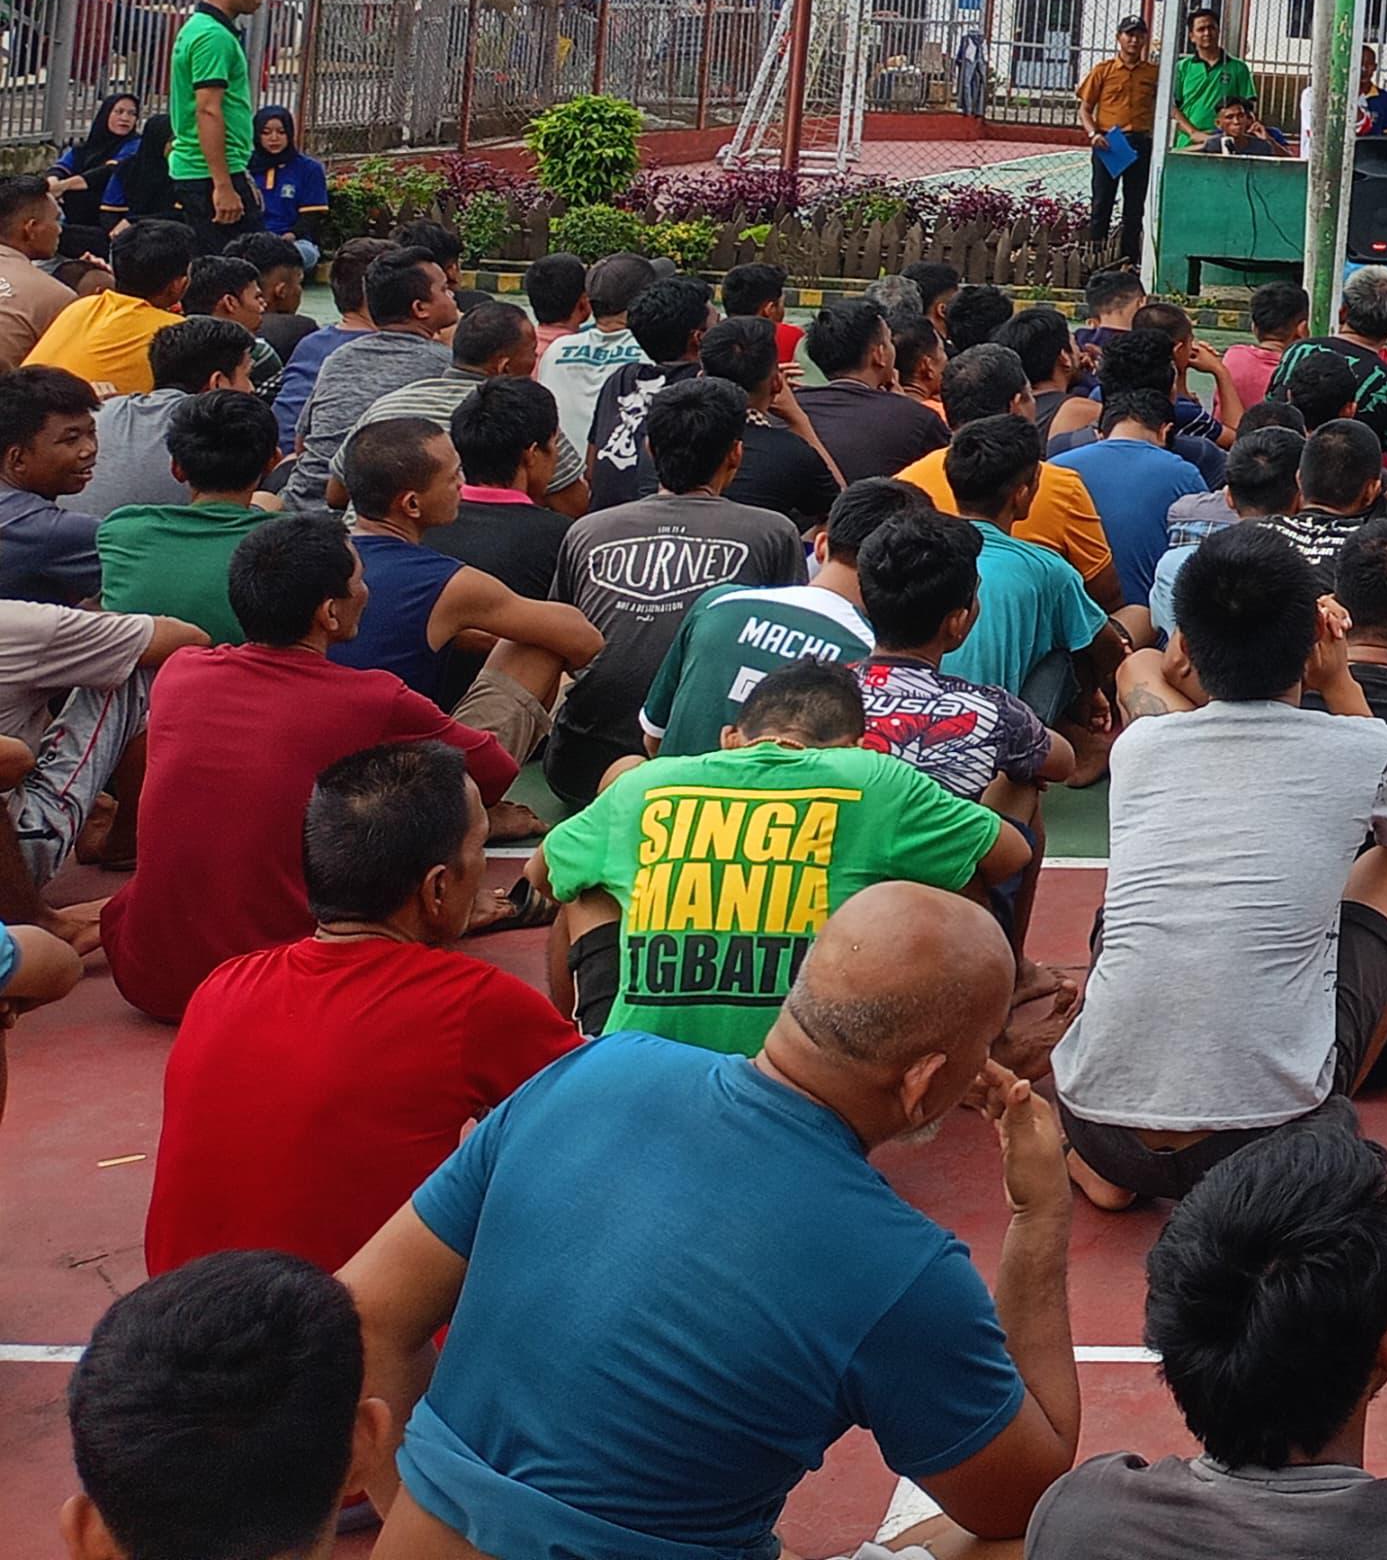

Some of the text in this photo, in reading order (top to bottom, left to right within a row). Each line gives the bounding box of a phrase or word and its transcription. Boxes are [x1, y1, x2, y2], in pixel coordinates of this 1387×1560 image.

[597, 540, 736, 591] JOURNEY
[737, 616, 842, 665] MACHO
[639, 798, 839, 866] SINGA
[626, 861, 829, 934] MANIA
